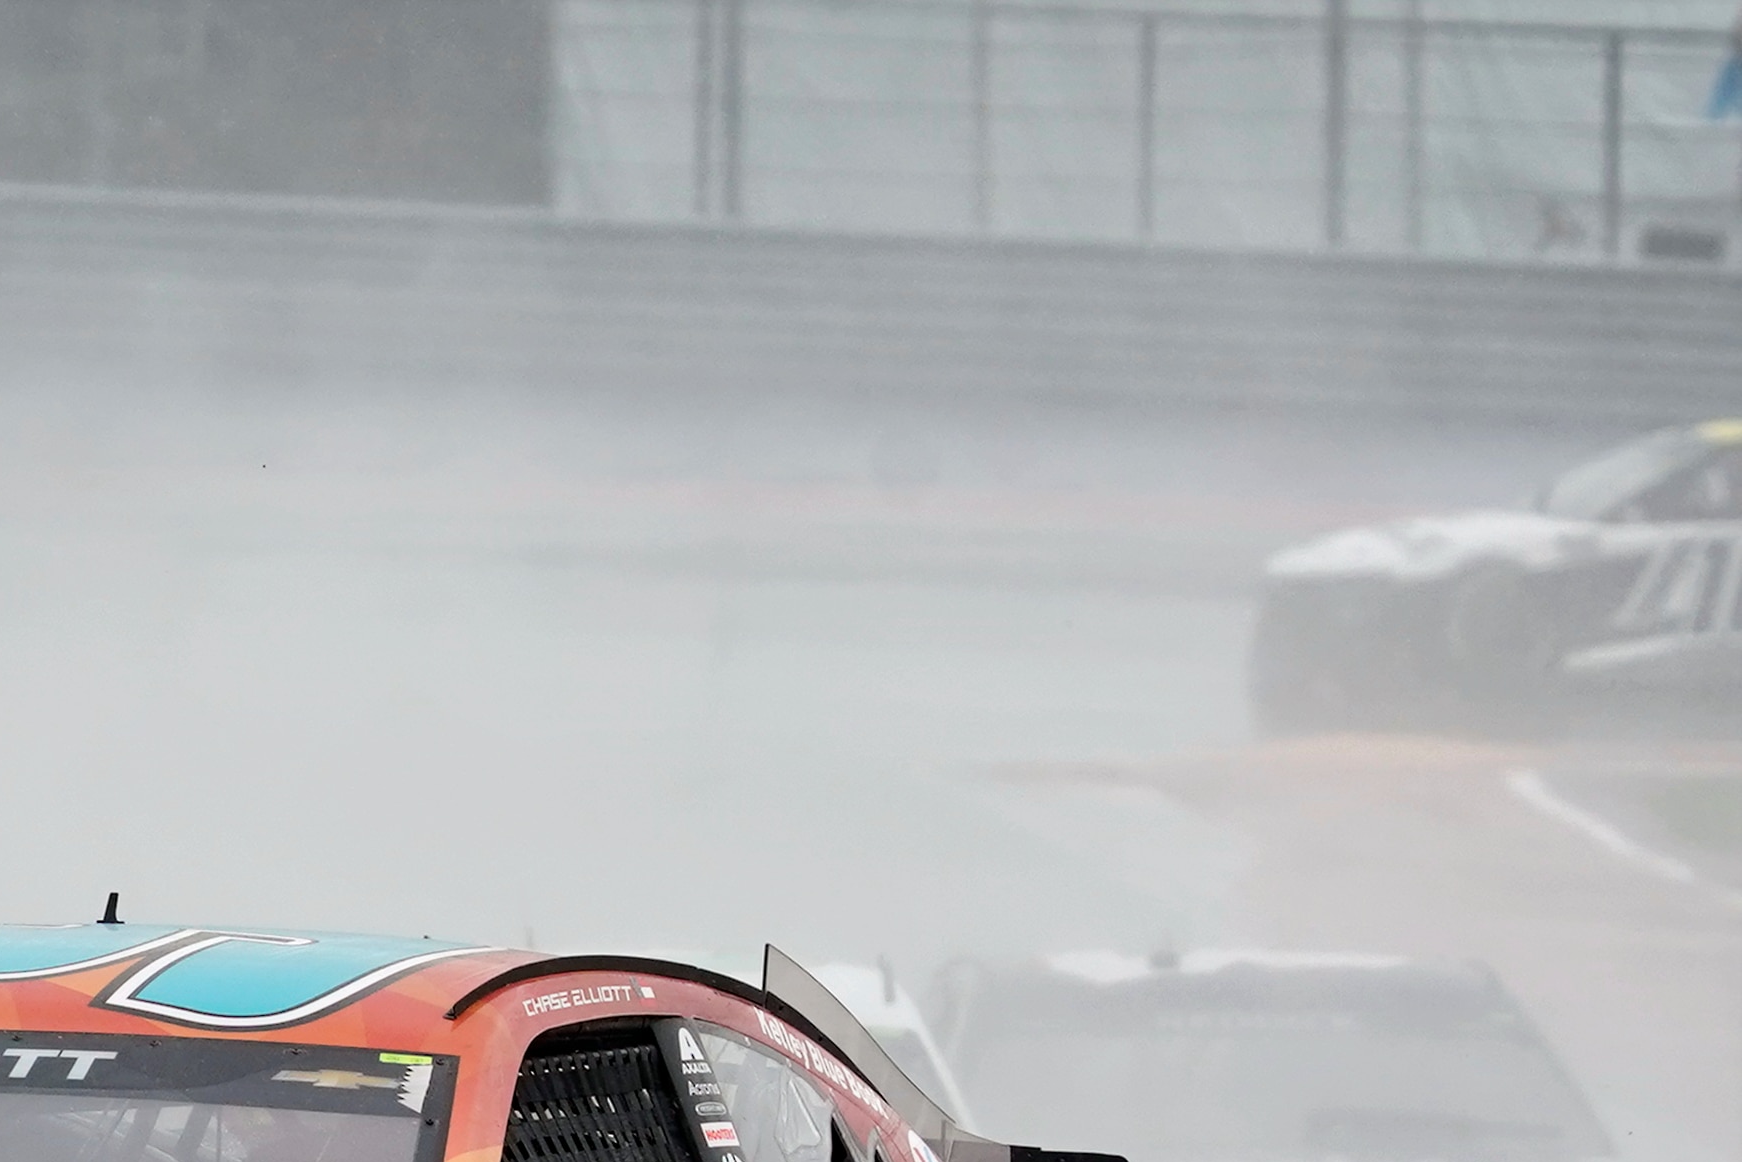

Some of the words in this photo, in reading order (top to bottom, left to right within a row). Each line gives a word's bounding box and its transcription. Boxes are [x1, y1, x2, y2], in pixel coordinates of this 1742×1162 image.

[522, 991, 572, 1017] CHASE
[570, 985, 632, 1007] ELLIOTT
[753, 1005, 810, 1070] Kelley
[804, 1039, 850, 1090] Blue
[681, 1061, 713, 1075] AXALTA
